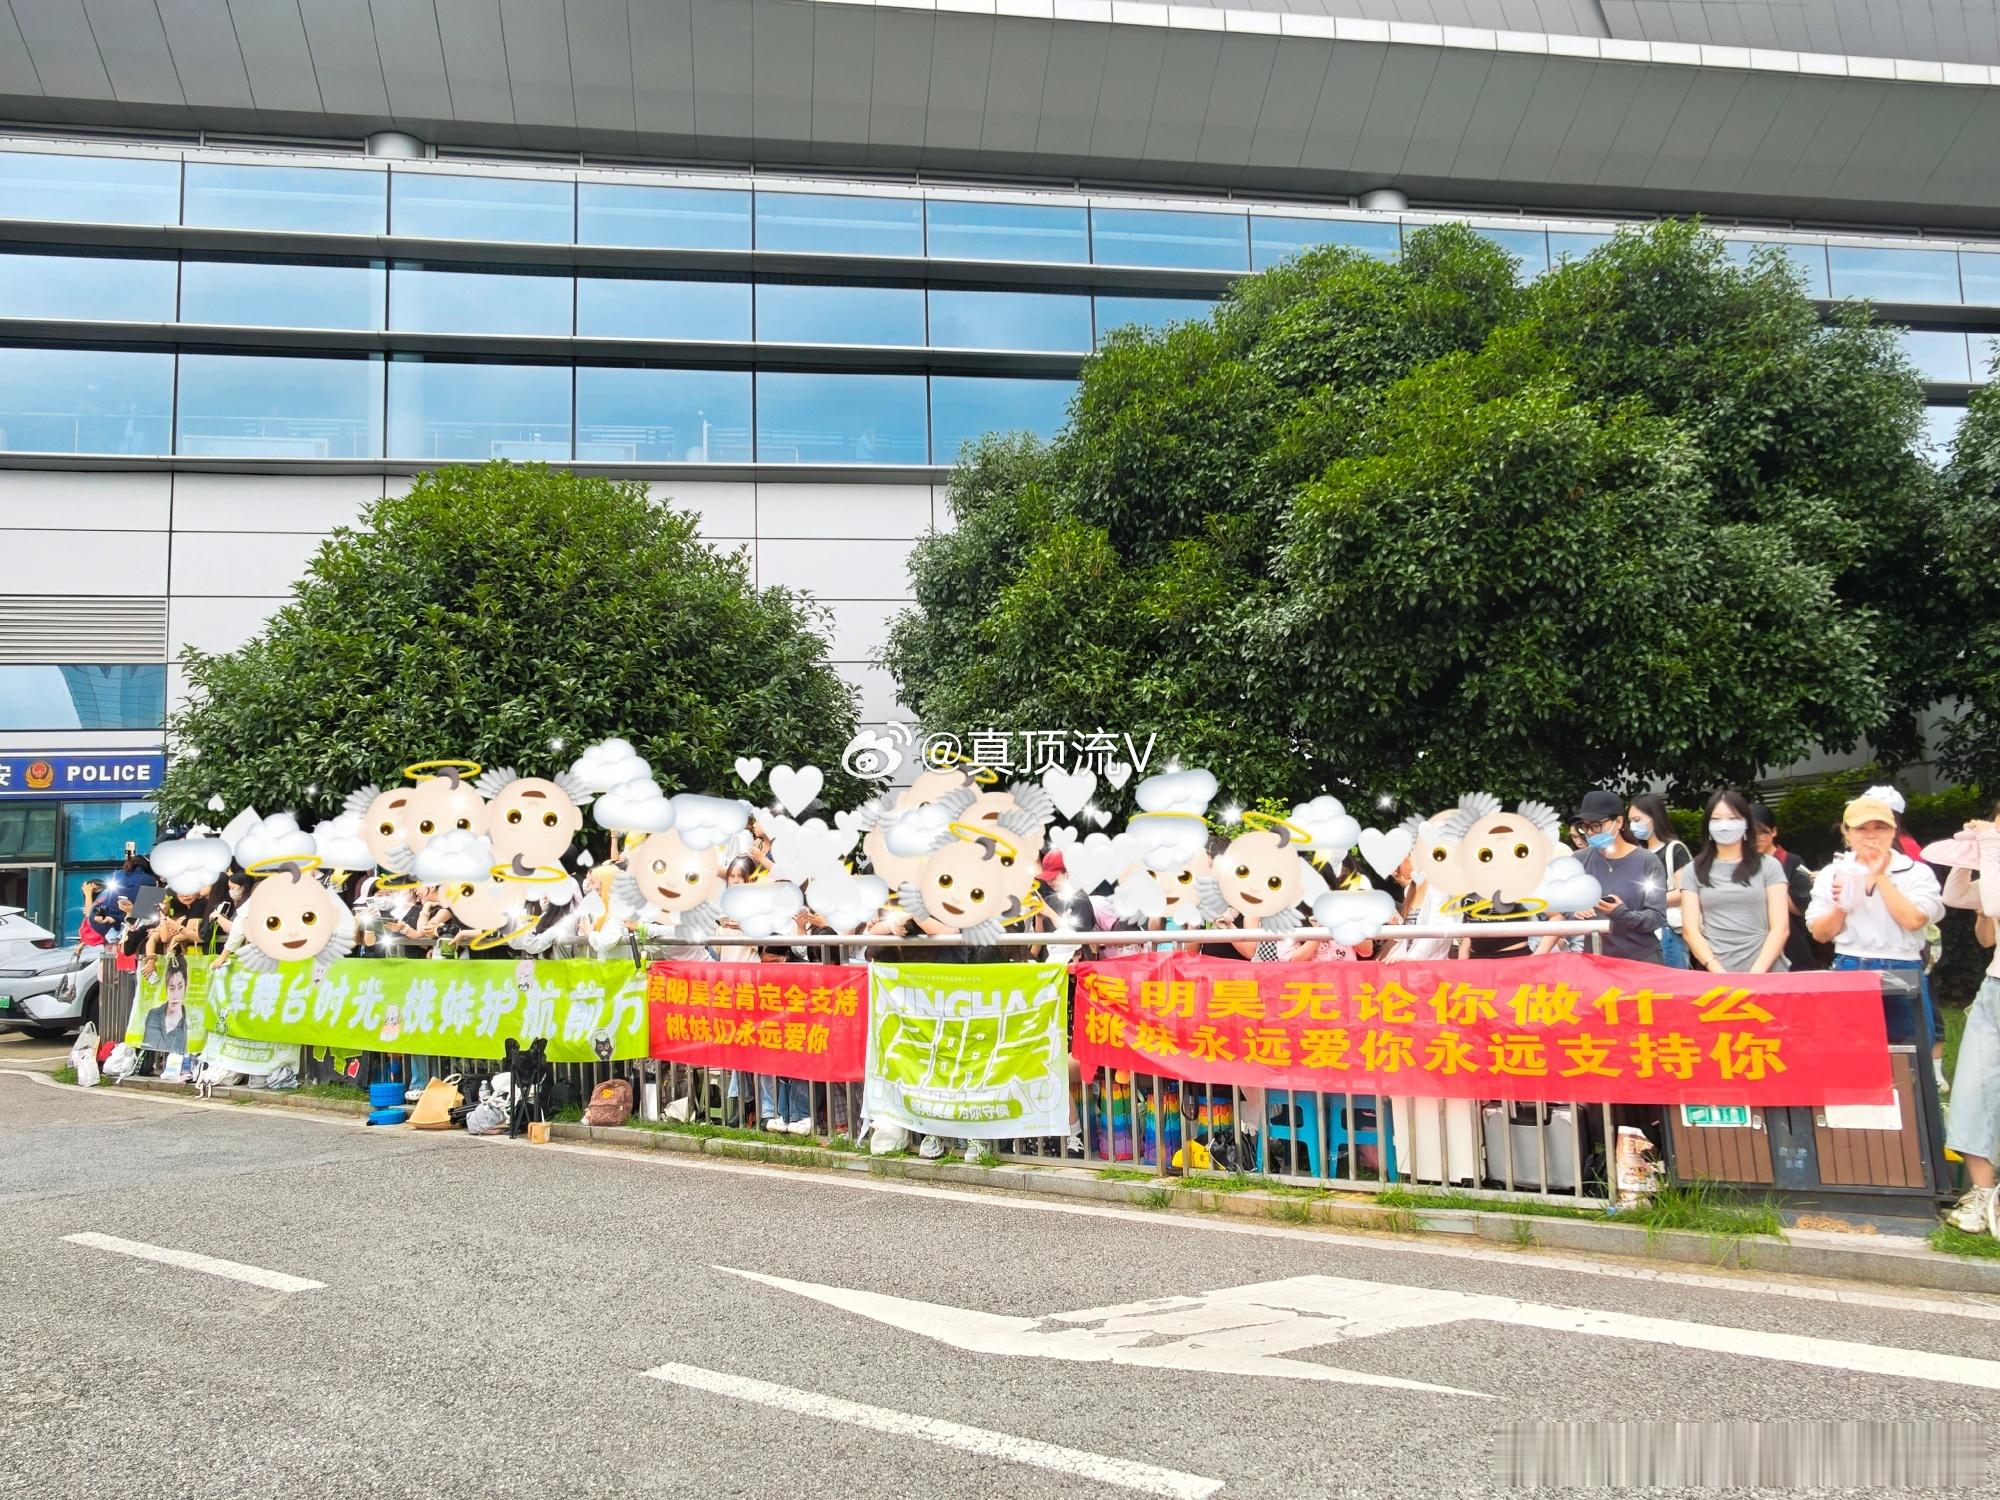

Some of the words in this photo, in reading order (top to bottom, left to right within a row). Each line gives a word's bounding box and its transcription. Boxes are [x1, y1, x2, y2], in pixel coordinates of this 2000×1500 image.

[67, 765, 151, 782] POLICE
[1084, 973, 1776, 1026] 侯明昊无论你做什么
[666, 1013, 830, 1055] 桃妹们永远爱你
[1085, 1008, 1788, 1081] 桃妹永远爱你永远支持你
